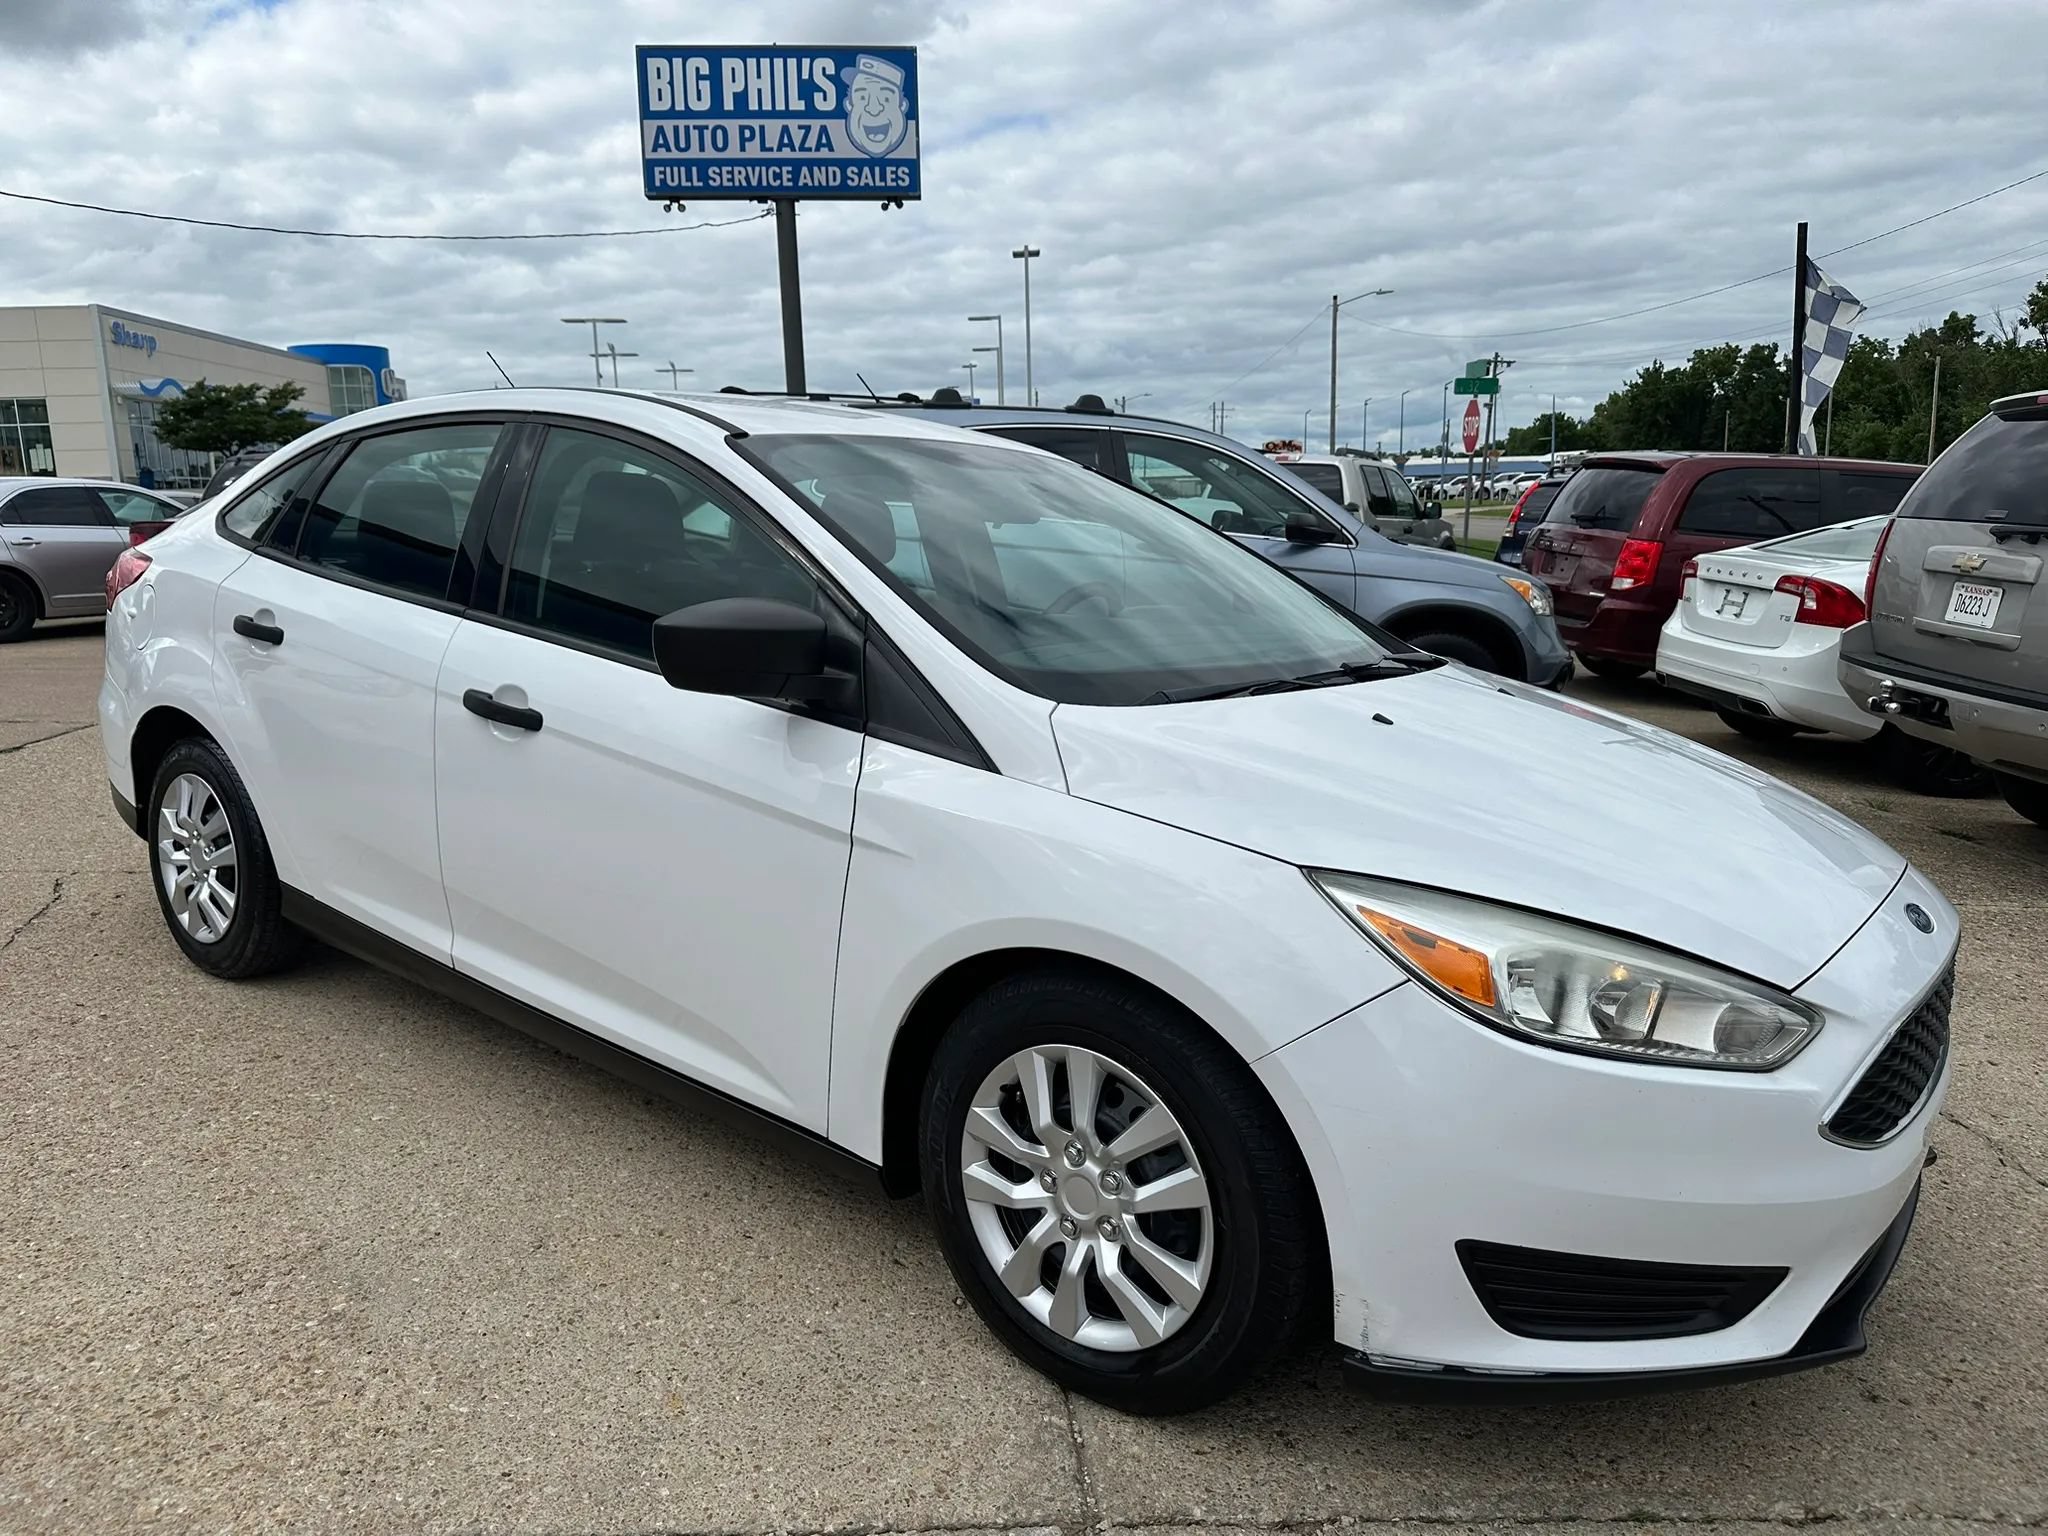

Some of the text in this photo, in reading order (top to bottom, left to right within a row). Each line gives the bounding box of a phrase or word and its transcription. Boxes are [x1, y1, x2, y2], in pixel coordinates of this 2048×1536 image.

[646, 57, 837, 111] BIG PHIL'S
[651, 124, 835, 153] AUTO PLAZA
[654, 166, 910, 187] FULL SERVICE AND SALES
[111, 320, 157, 358] Sharp
[1464, 416, 1479, 437] STOP
[1964, 585, 1990, 596] KANSAS
